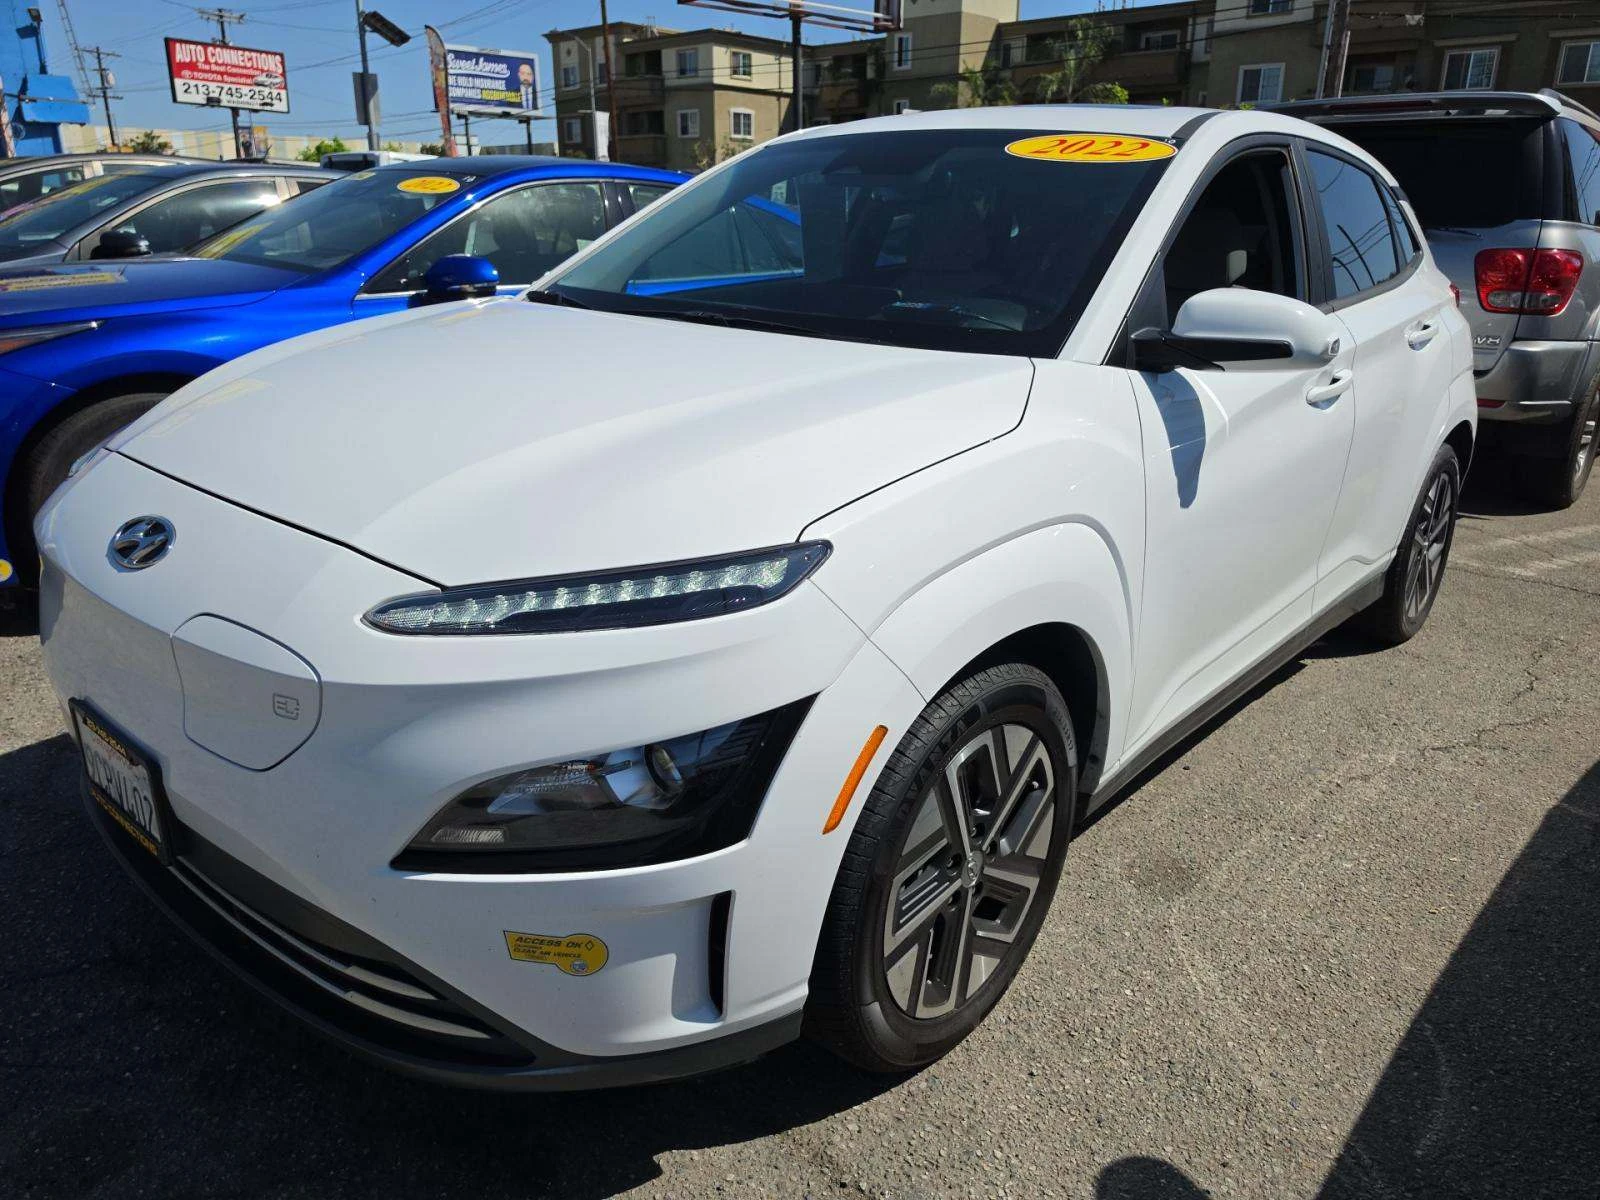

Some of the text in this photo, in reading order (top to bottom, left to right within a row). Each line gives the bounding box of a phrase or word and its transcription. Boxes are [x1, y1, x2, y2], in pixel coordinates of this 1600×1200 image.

[175, 42, 282, 74] AUTO CONNECTIONS
[193, 71, 222, 81] TOYOTA
[182, 82, 283, 103] 213-745-2544
[1029, 138, 1150, 156] 2022
[515, 936, 583, 949] ACCESS OK
[553, 951, 581, 959] VEHICLE
